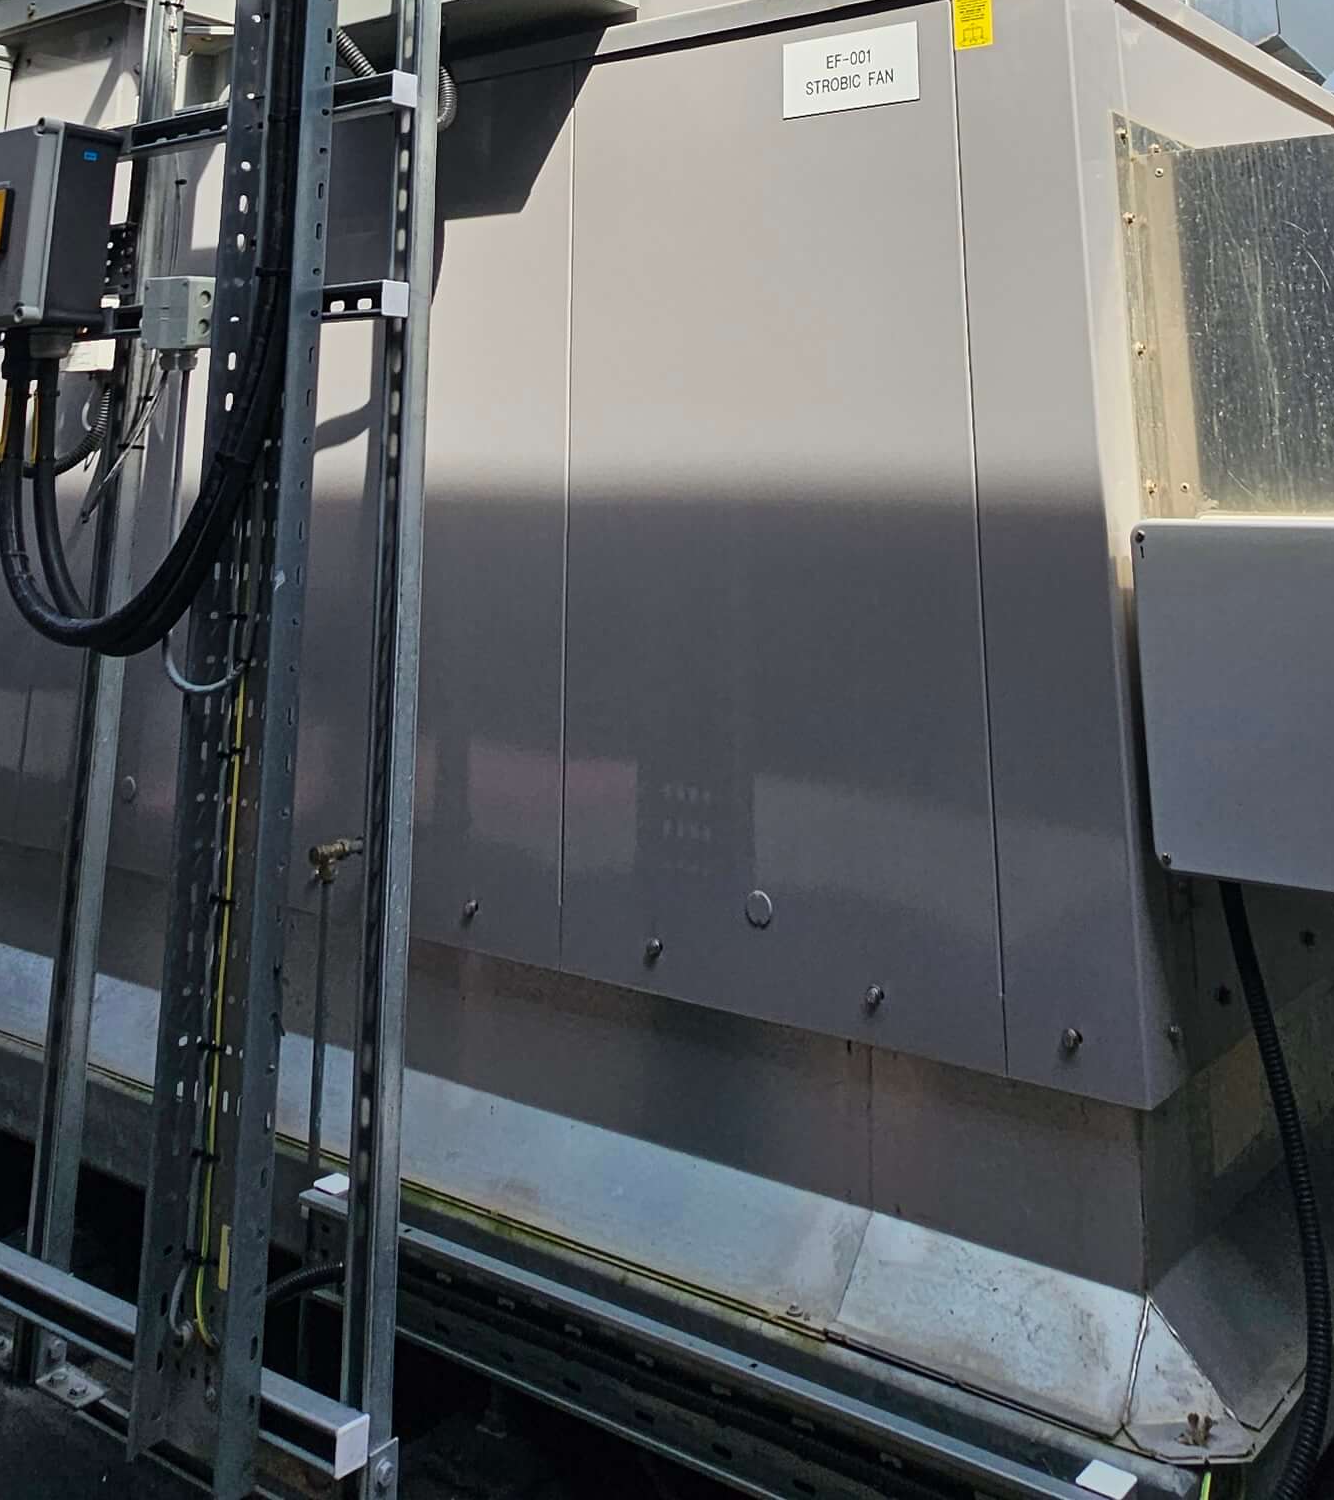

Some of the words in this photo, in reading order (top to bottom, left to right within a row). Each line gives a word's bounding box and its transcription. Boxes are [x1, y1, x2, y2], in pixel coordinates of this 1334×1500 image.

[826, 49, 871, 70] EF-001
[805, 73, 862, 96] STROBIC
[868, 67, 894, 86] FAN
